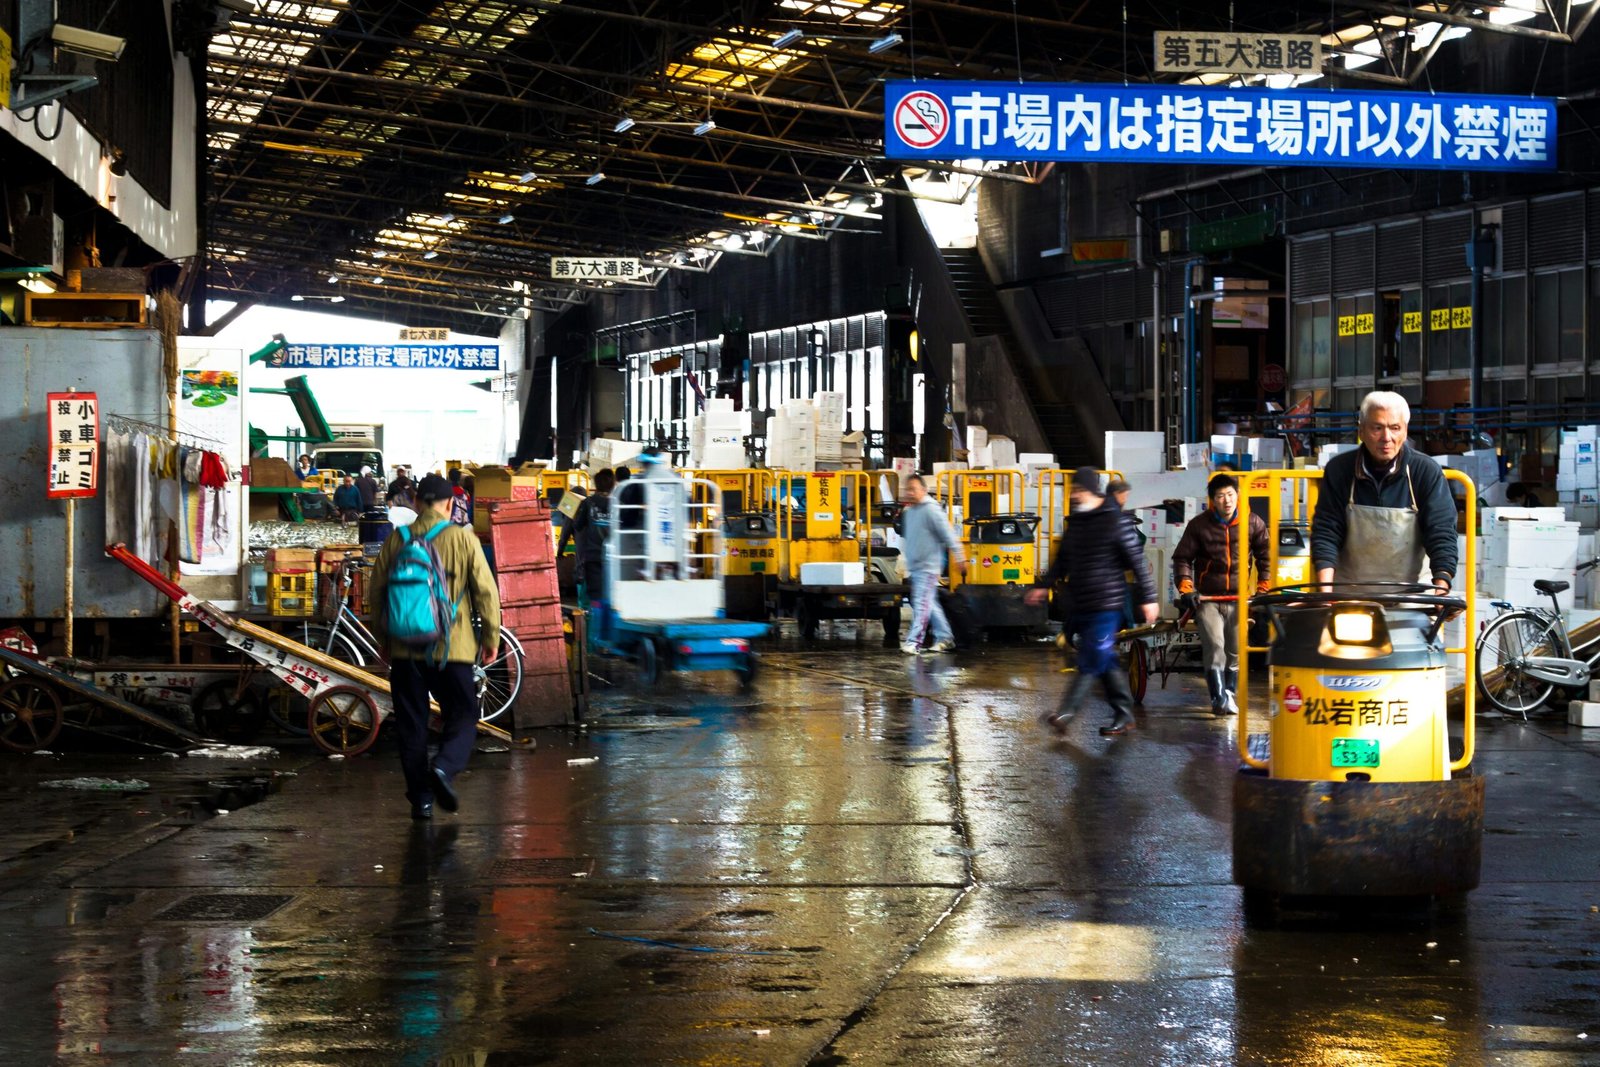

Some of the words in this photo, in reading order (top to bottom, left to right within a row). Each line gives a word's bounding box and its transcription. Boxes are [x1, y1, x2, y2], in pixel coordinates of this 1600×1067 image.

[1163, 36, 1313, 70] 第五大通路
[952, 92, 1547, 162] 市場内は指定場所以外禁煙
[555, 260, 634, 276] 第六大通路
[400, 329, 448, 341] 第七大通路
[288, 346, 497, 368] 市場内は指定場所以外禁煙
[57, 401, 72, 485] 投棄禁止
[77, 401, 96, 489] 小車ゴミ
[818, 477, 830, 507] 佐和久
[1002, 555, 1022, 565] 大仲
[1304, 697, 1409, 726] 松岩商店
